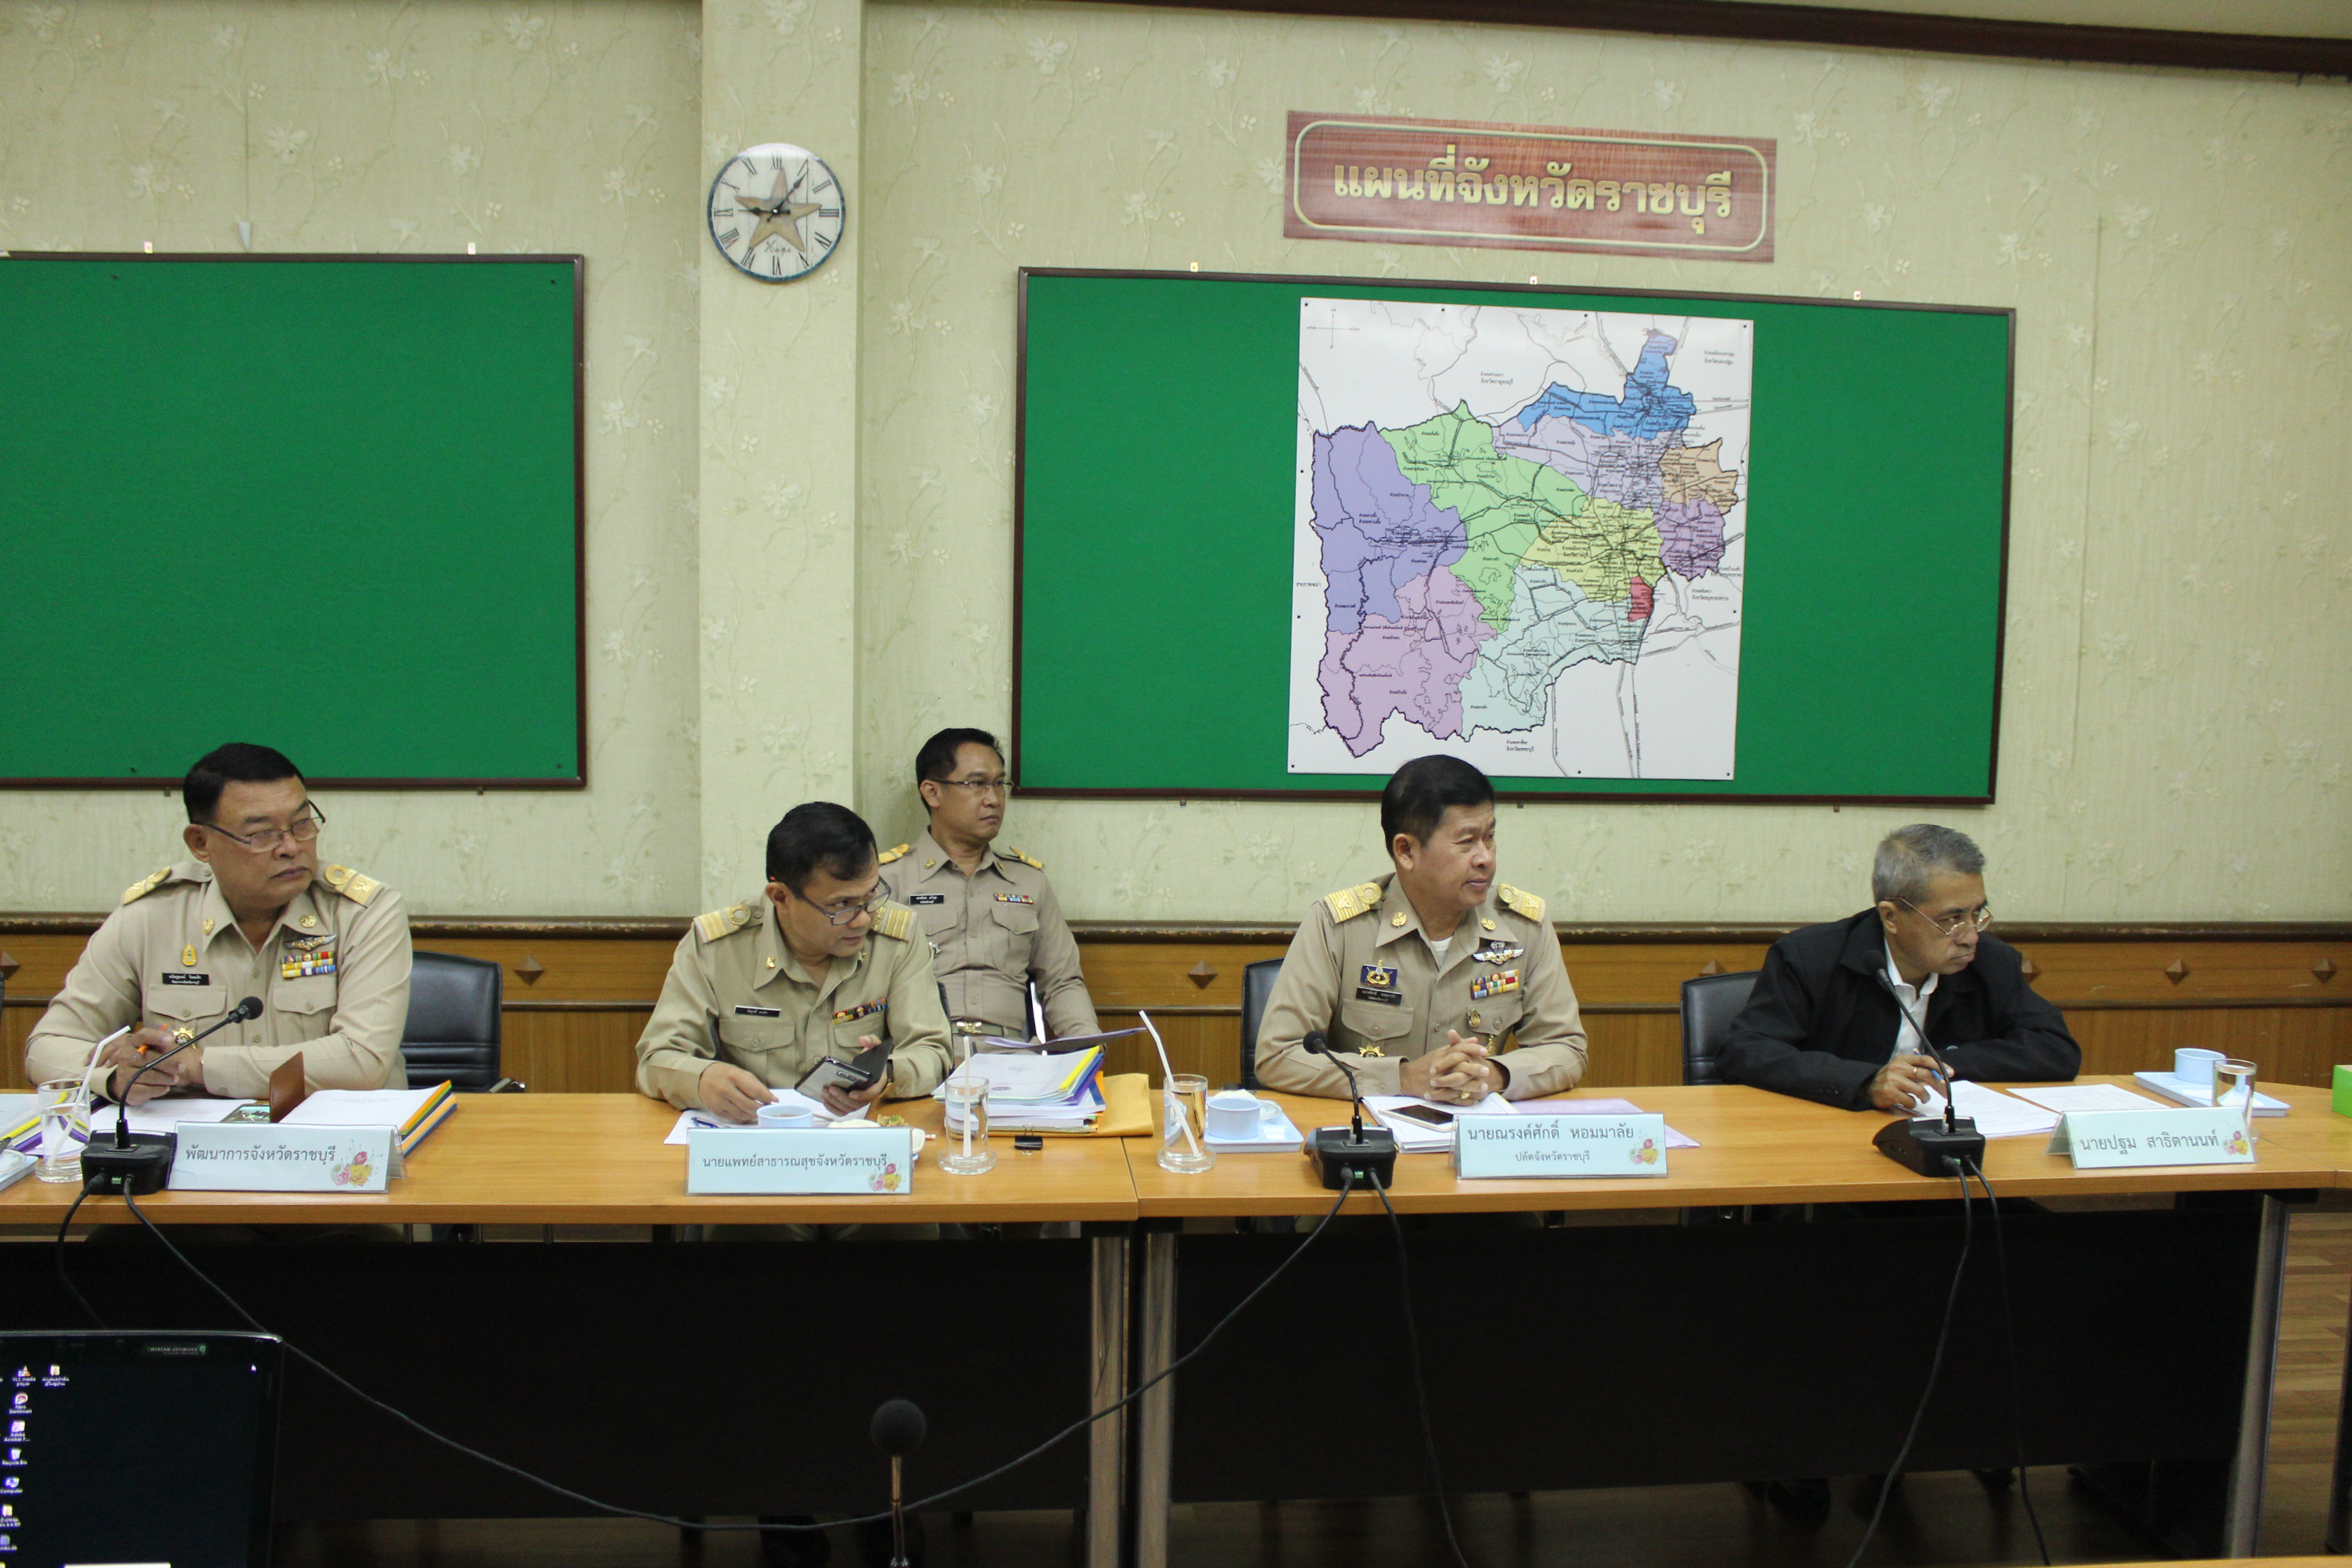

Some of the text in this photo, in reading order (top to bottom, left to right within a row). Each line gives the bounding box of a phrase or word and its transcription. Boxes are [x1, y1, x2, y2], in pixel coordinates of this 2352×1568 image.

[1333, 144, 1731, 234] แผนที่จังหวัดราชบุรี
[1468, 1119, 1634, 1141] นายณรงค์ศักดิ์ หอมมาลัย
[2080, 1129, 2219, 1155] นายปฐม สาธิตานนท์
[185, 1145, 336, 1166] พัฒนาการจังหวัดราชบุรี
[702, 1153, 887, 1171] นายแพทย์สาธารณสุขจังหวัดราชบุรี
[1514, 1150, 1591, 1164] ปลัดจังหวัดราชบุรี
